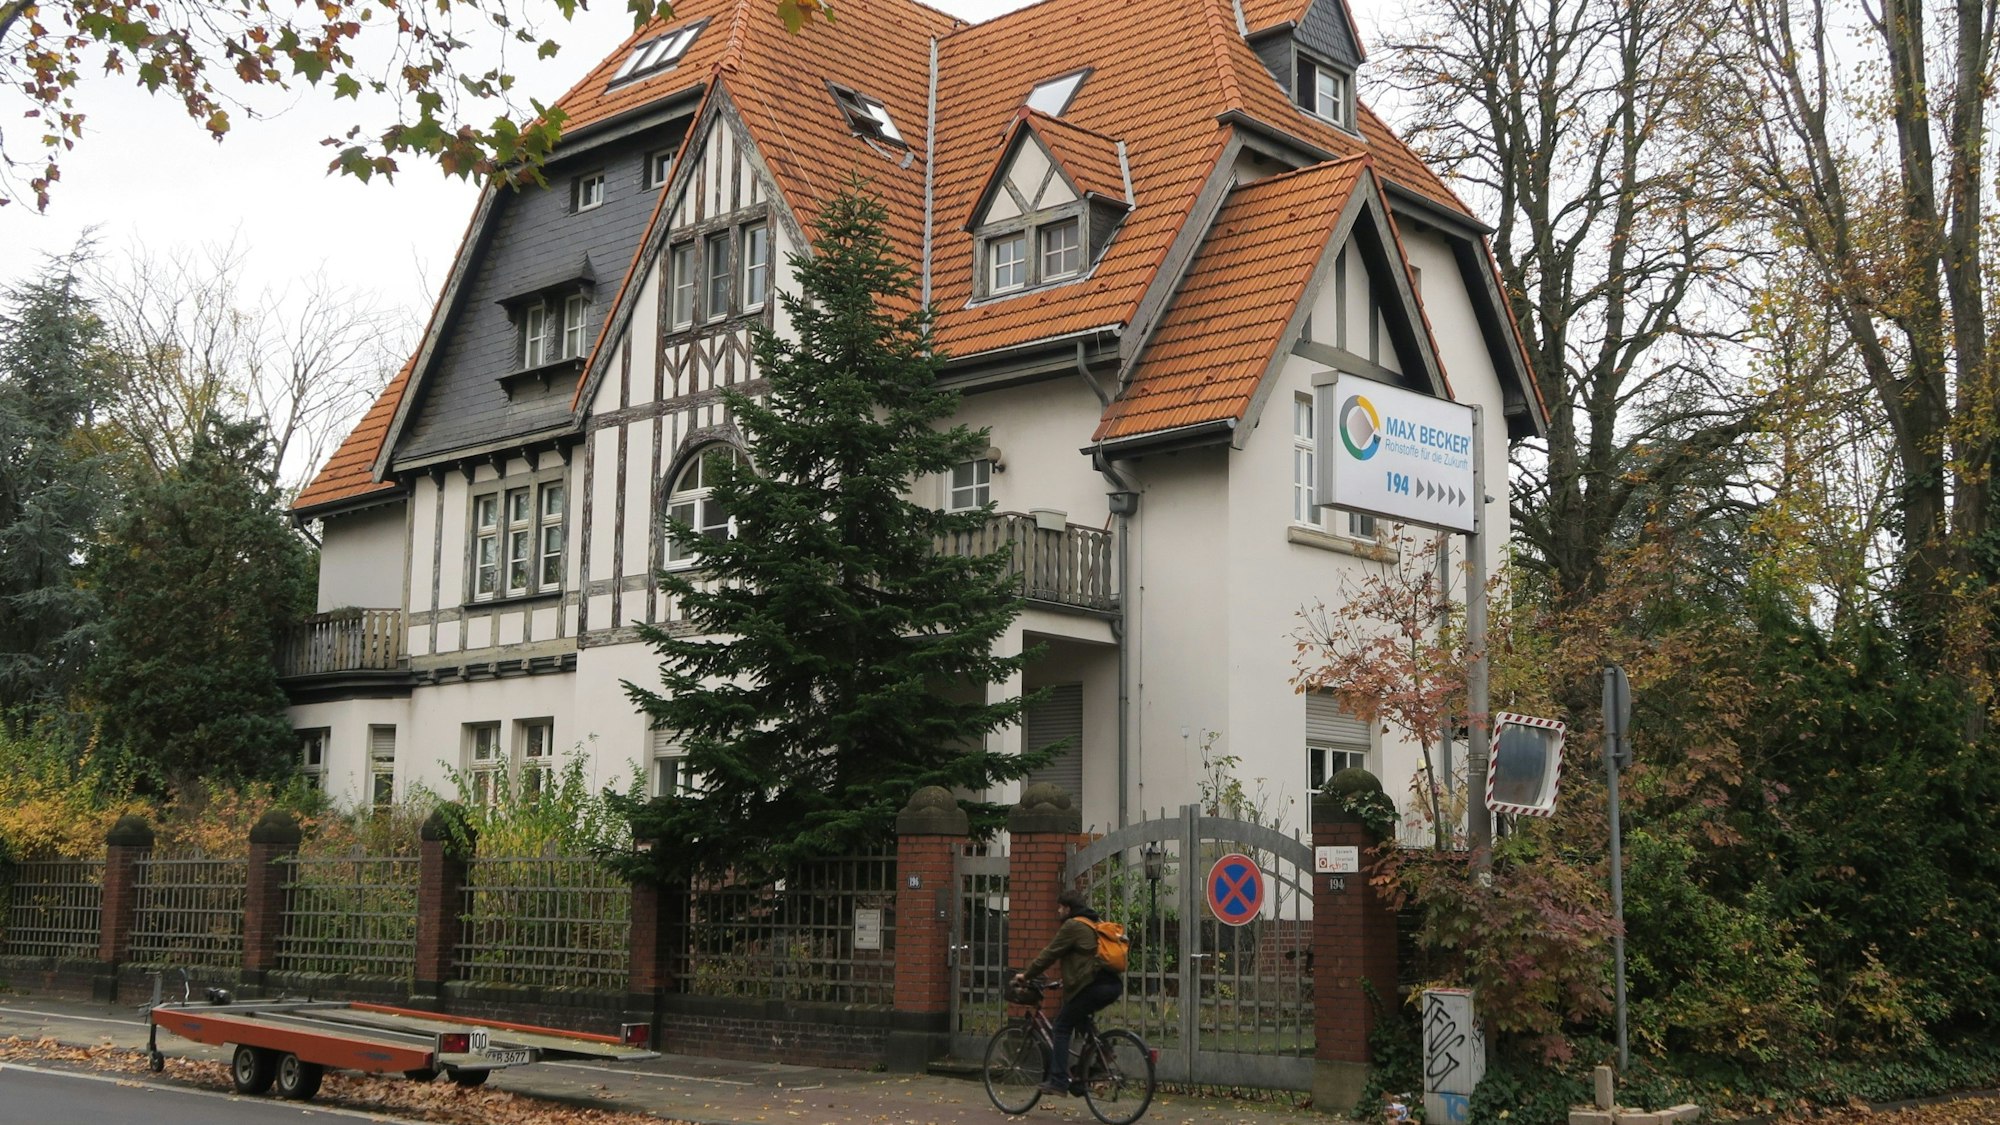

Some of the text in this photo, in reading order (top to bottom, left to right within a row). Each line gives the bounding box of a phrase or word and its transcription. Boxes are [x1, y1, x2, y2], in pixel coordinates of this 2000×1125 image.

[1386, 417, 1468, 455] MAX BECKER
[1385, 439, 1468, 469] Rohstoffe für die Zukunft
[1387, 472, 1409, 495] 194
[1329, 878, 1344, 890] 194
[471, 1032, 487, 1049] 100
[504, 1051, 526, 1063] 3677
